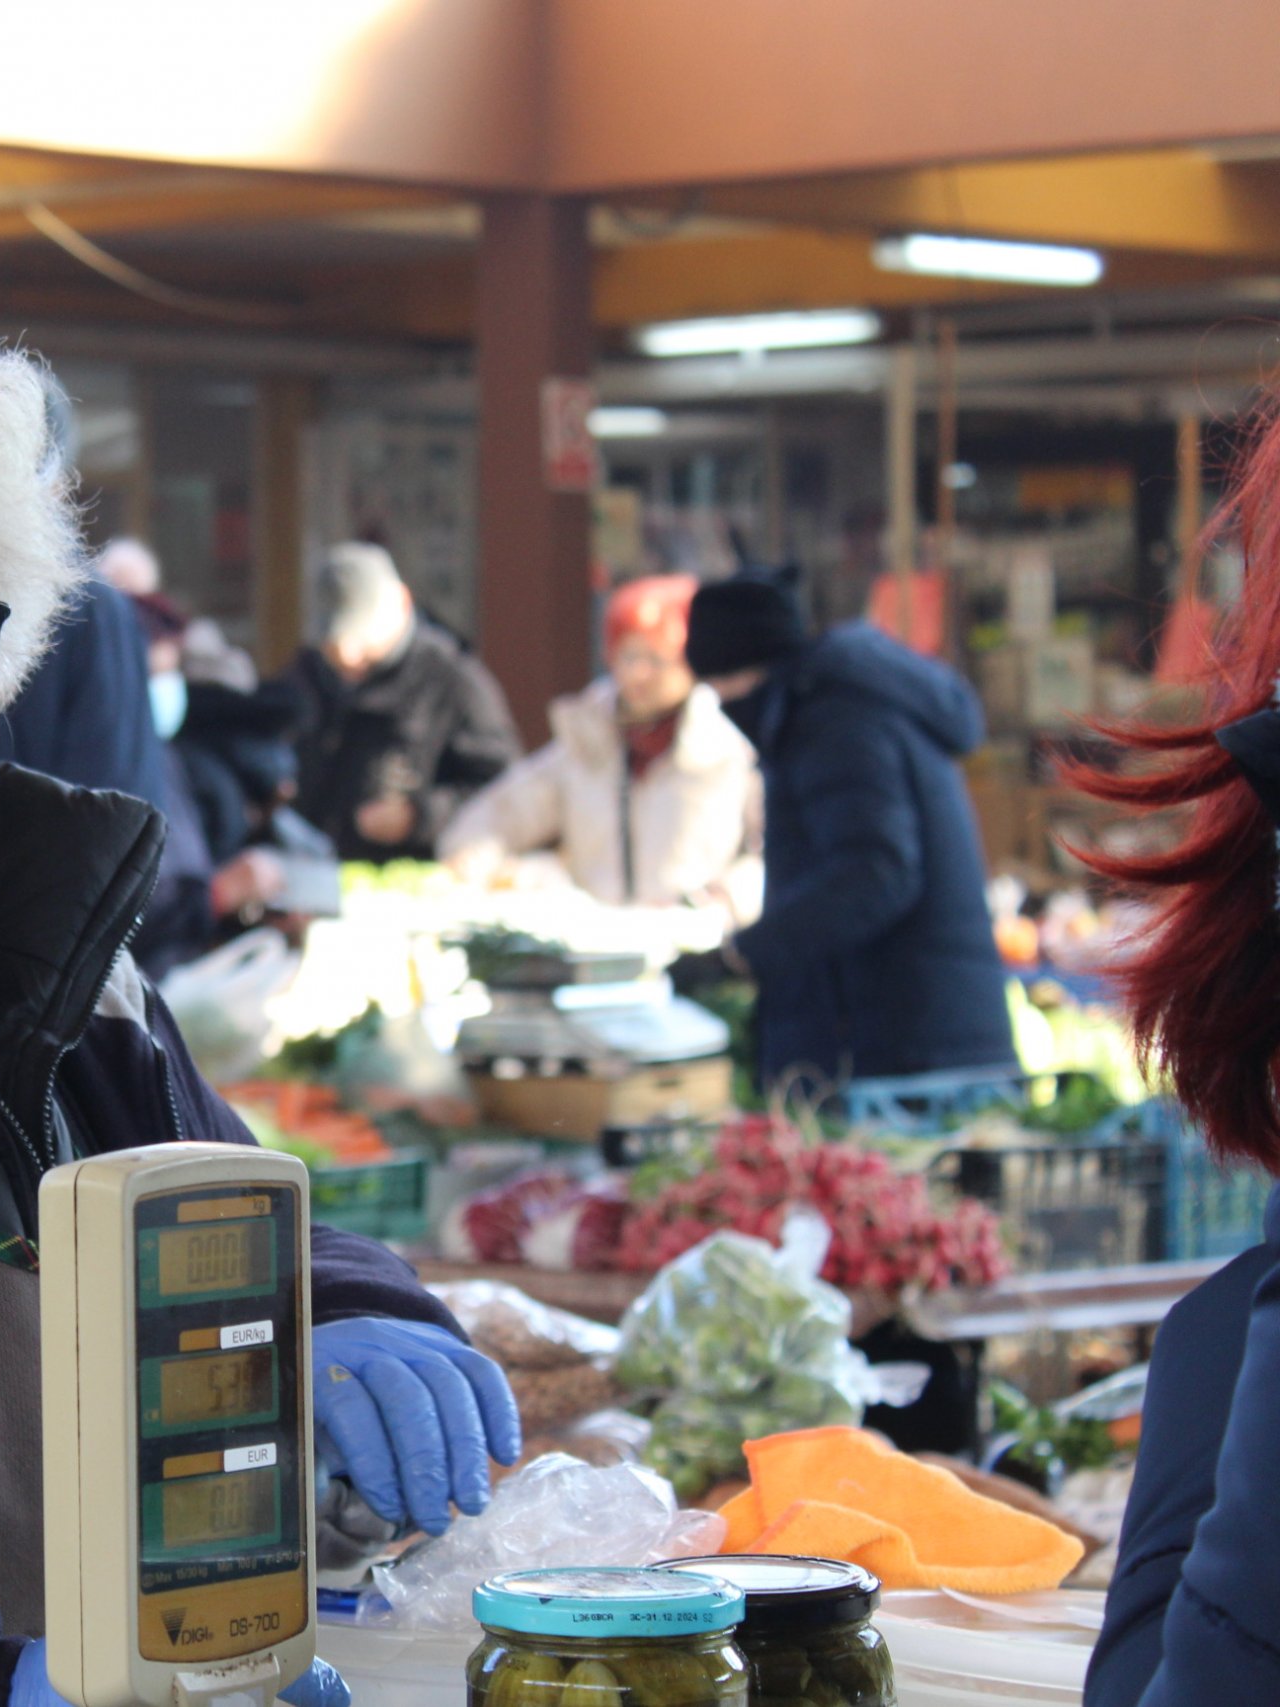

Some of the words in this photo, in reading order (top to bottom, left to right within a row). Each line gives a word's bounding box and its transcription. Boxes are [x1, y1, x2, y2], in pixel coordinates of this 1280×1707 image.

[253, 1197, 265, 1214] kg
[232, 1328, 266, 1344] EUR/kg
[248, 1448, 268, 1463] EUR
[181, 1626, 210, 1646] DIGI
[229, 1612, 280, 1637] DS-700
